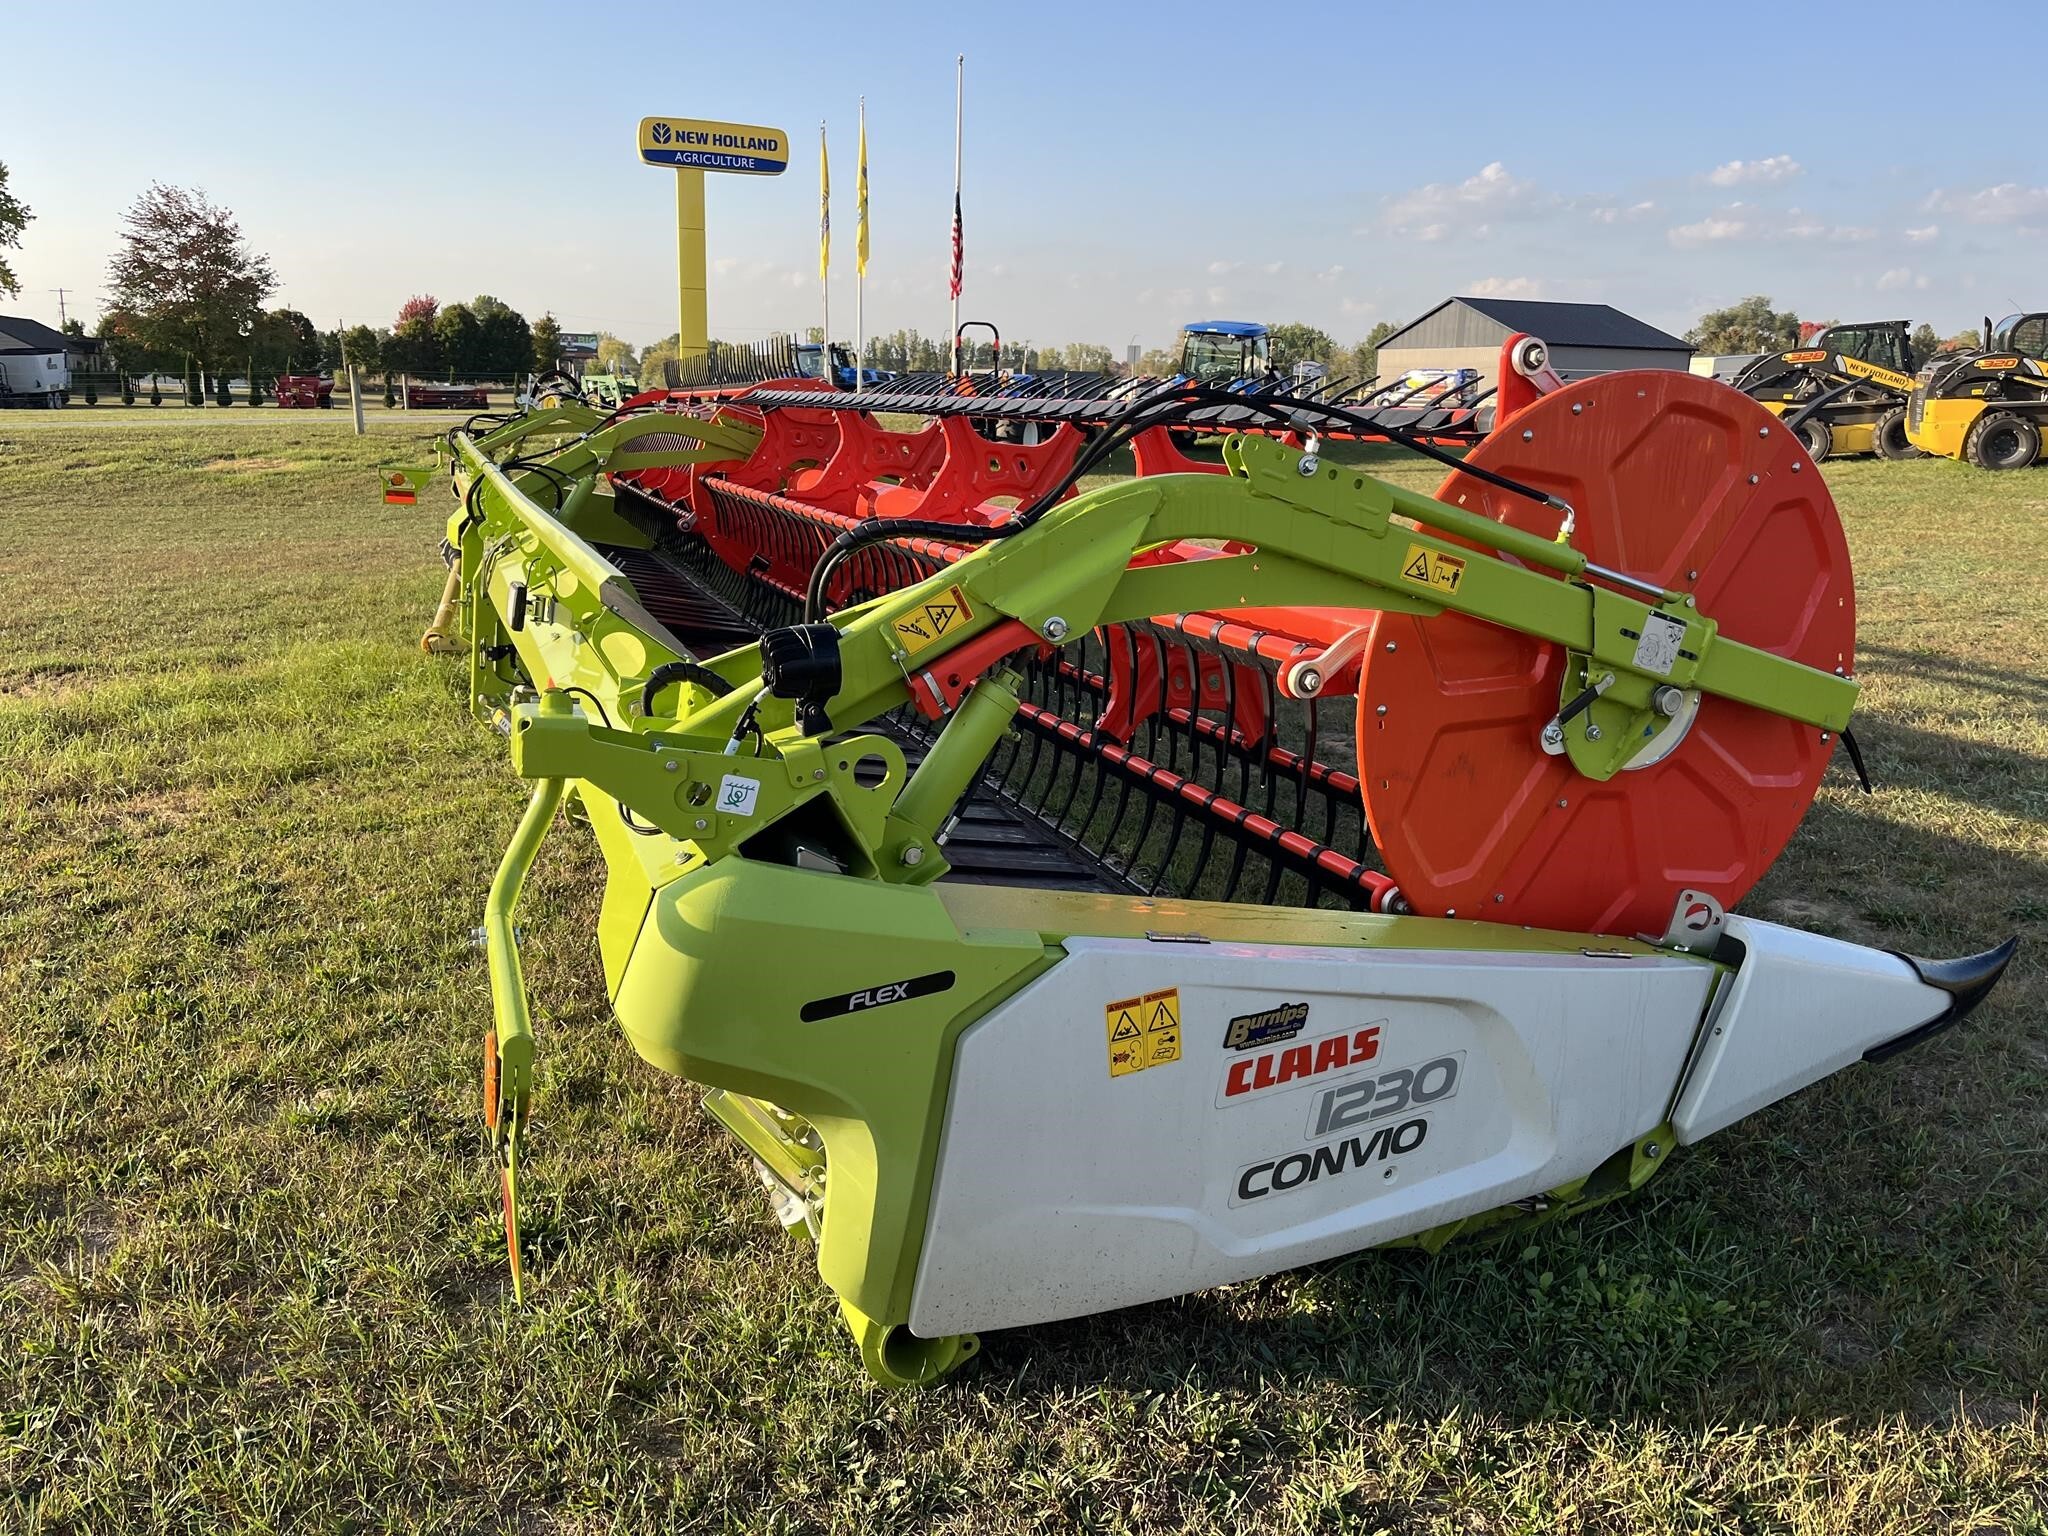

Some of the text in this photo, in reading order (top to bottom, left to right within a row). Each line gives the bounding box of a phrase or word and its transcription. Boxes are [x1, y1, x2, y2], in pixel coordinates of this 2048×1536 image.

[675, 130, 778, 152] NEW HOLLAND
[674, 152, 755, 169] AGRICULTURE
[1849, 362, 1907, 386] NEW HOLLAND
[848, 982, 910, 1011] FLEX
[1227, 1005, 1308, 1047] Burnips
[1225, 1026, 1381, 1097] CLAAS
[1314, 1057, 1458, 1136] 1230
[1237, 1118, 1428, 1200] CONVIO
